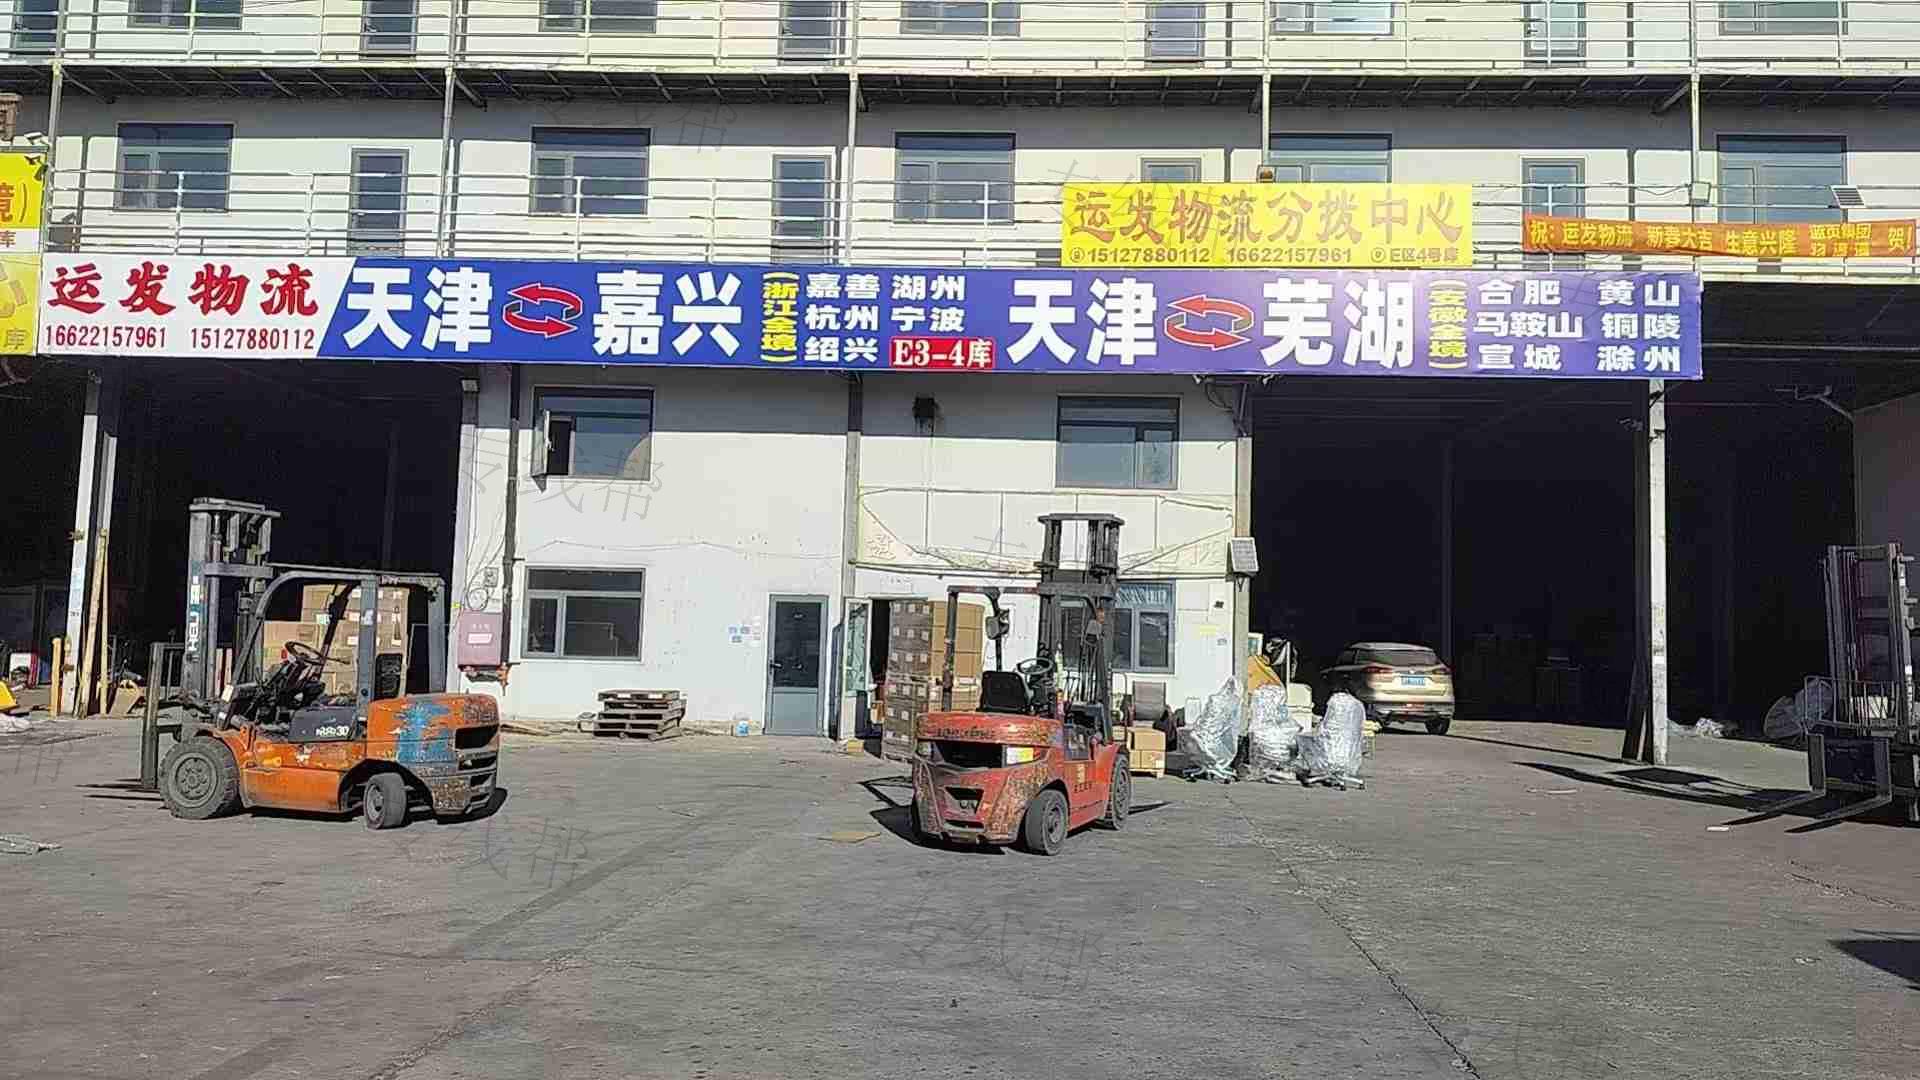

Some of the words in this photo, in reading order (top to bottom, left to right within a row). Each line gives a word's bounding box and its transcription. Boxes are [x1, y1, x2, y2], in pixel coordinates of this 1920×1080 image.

[1069, 190, 1463, 245] 运发物流分拨中心
[1562, 222, 1633, 247] 运发物流
[1647, 225, 1712, 250] 新春大吉
[1725, 229, 1799, 255] 生意兴隆
[1088, 246, 1210, 263] 15127880112
[1226, 246, 1352, 263] 16622157961
[47, 262, 319, 316] 运发物流
[805, 273, 881, 301] 嘉善
[891, 275, 967, 302] 湖州
[1477, 279, 1562, 306] 合肥
[1598, 280, 1680, 308] 黄山
[343, 266, 493, 352] 天津
[592, 269, 742, 357] 嘉兴
[804, 304, 880, 332] 杭州
[890, 306, 966, 333] 宁波
[1006, 277, 1157, 366] 天津
[1260, 277, 1414, 369] 芜湖
[1473, 311, 1584, 339] 马鞍山
[1601, 312, 1682, 340] 铜陵
[45, 325, 166, 349] 16622157961
[190, 327, 315, 351] 15127880112
[804, 336, 880, 363] 绍兴
[893, 338, 992, 367] E3-4库
[1477, 344, 1562, 371] 宣城
[1597, 346, 1682, 373] 滁州
